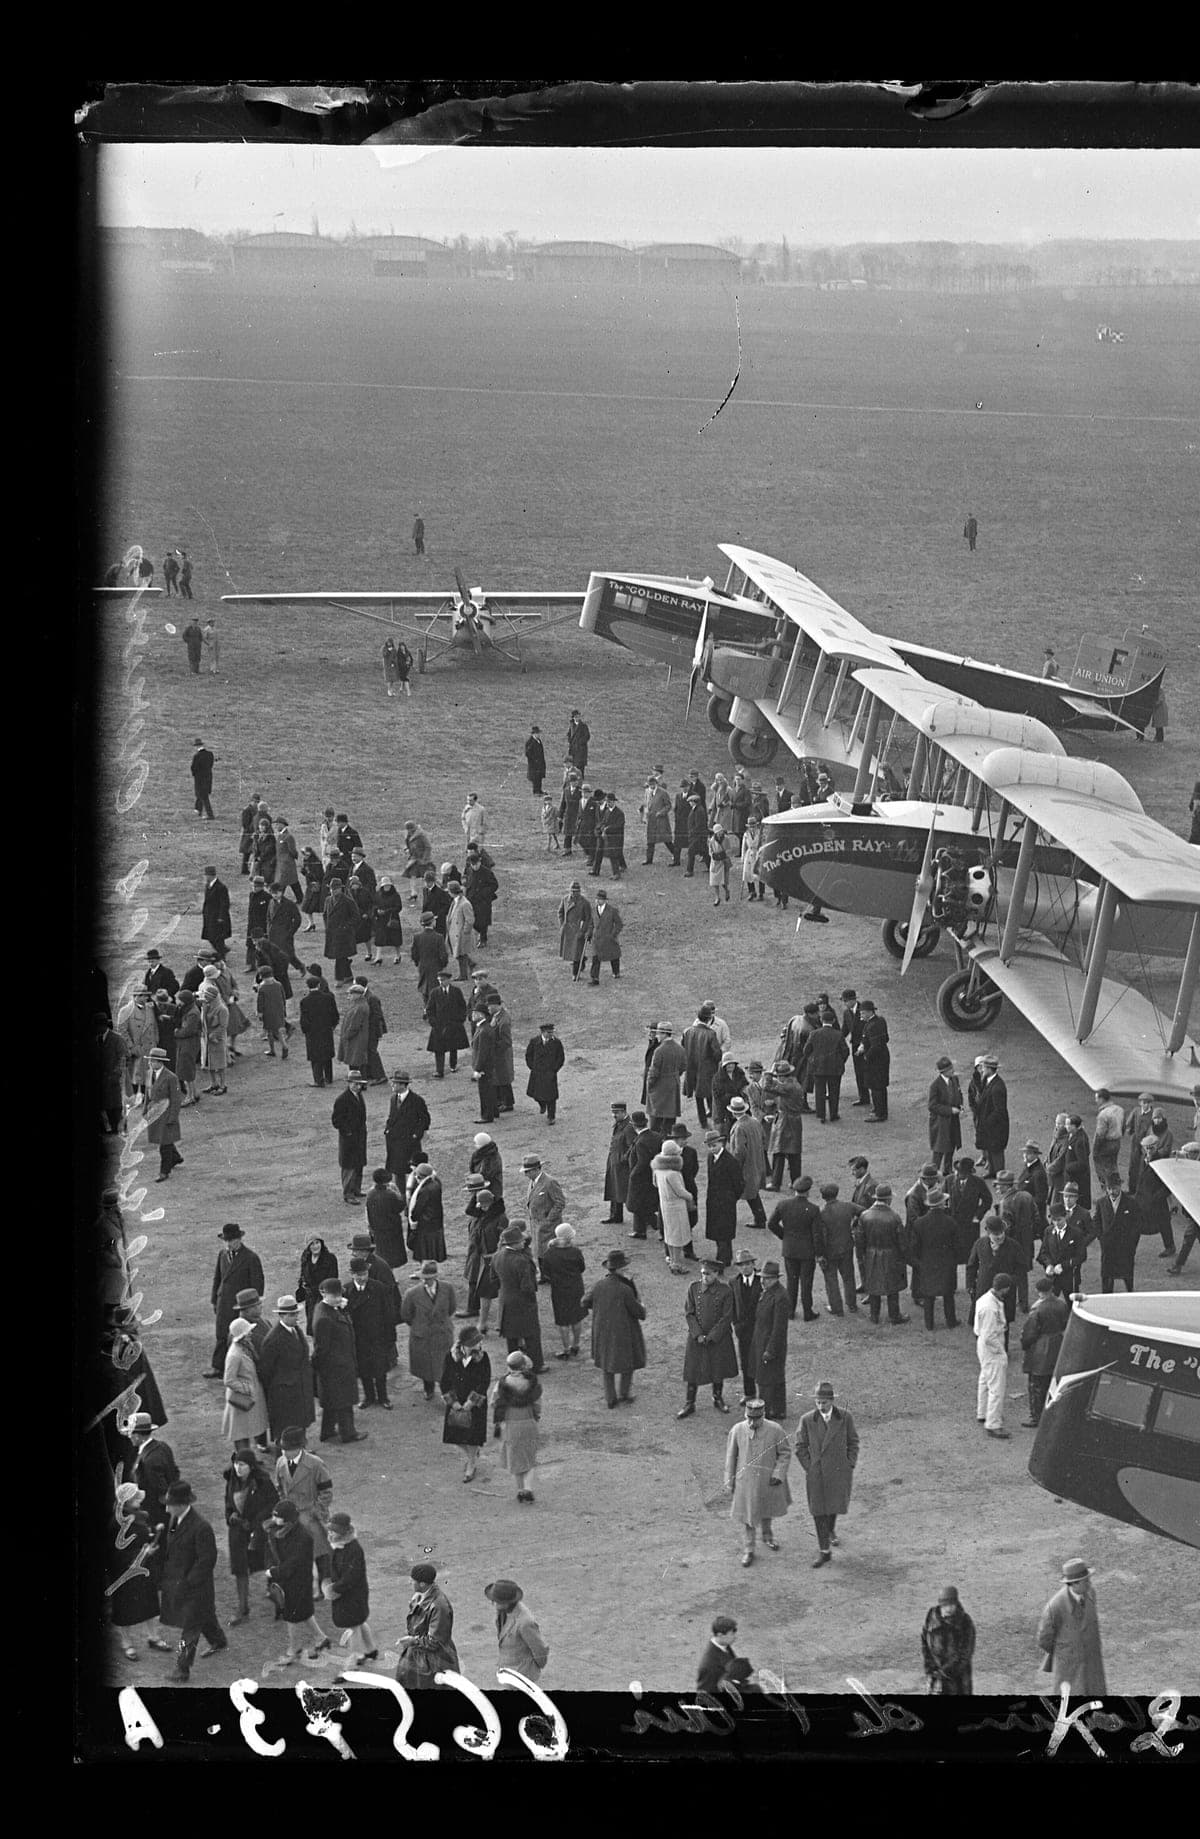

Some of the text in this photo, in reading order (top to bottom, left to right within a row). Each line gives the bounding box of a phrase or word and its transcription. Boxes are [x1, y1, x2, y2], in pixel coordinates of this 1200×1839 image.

[1108, 648, 1129, 674] F
[1075, 668, 1092, 679] AIR
[1095, 672, 1126, 687] UNION
[763, 859, 782, 873] The
[1130, 1344, 1175, 1374] The
